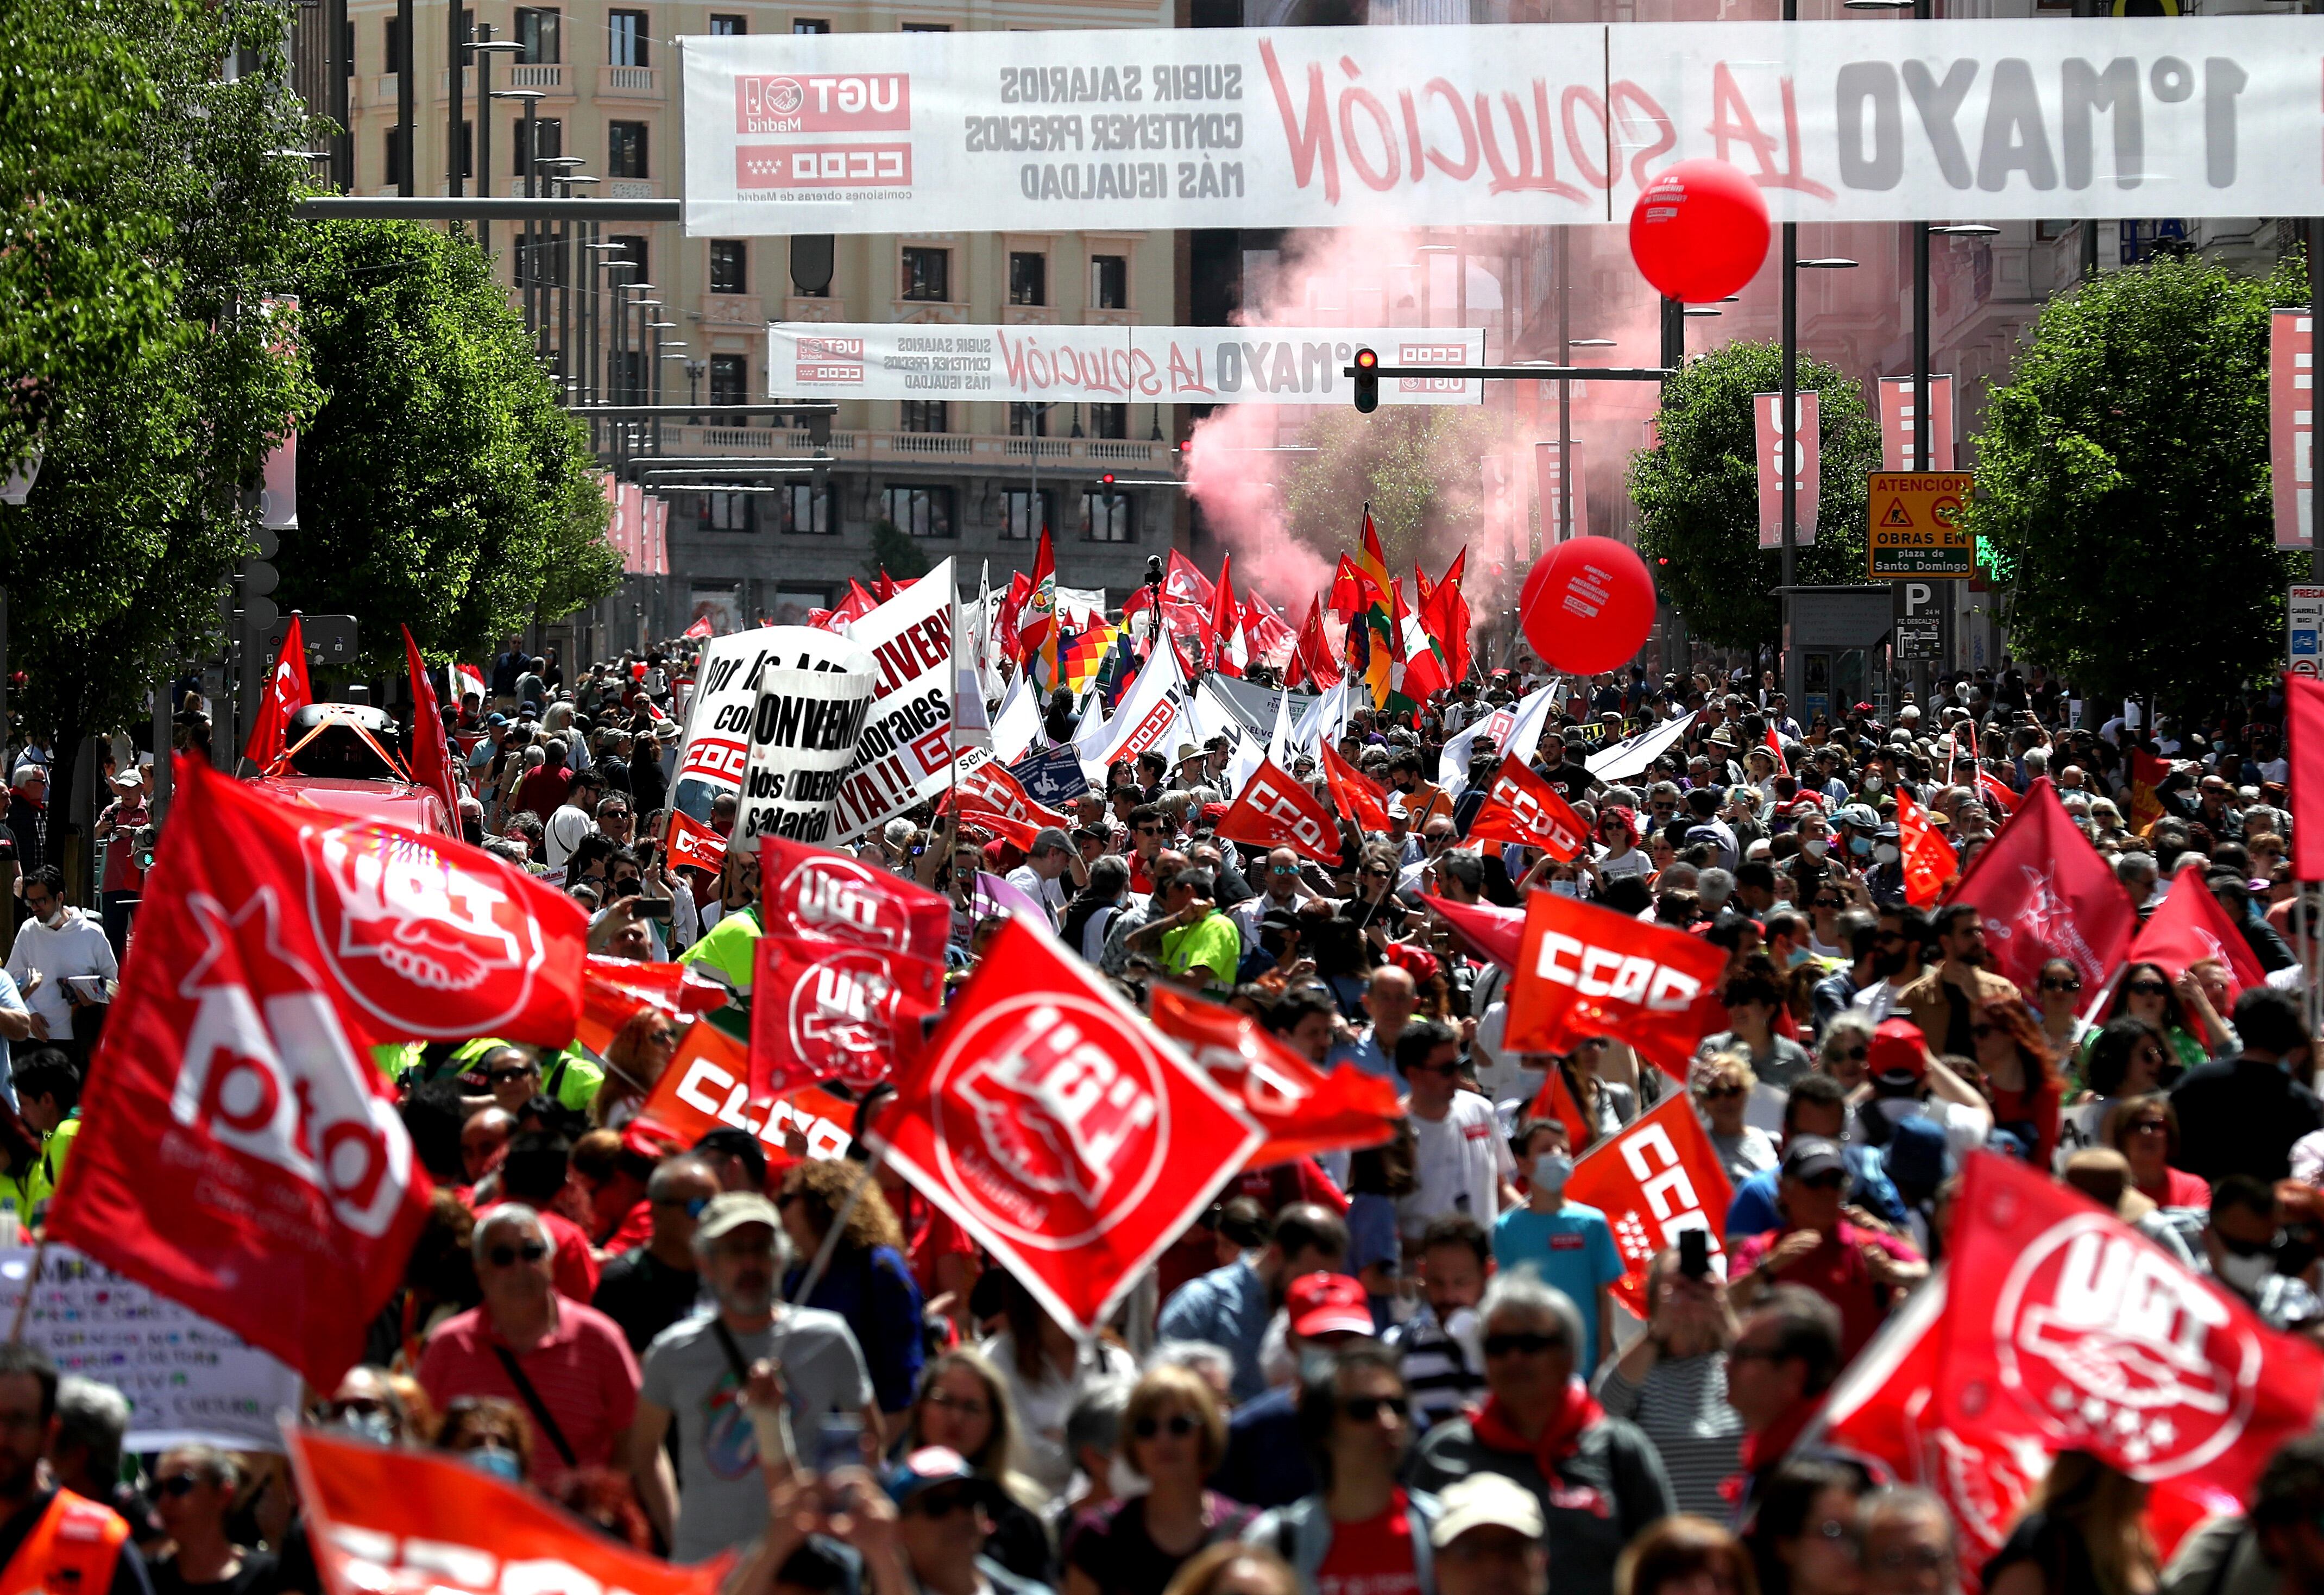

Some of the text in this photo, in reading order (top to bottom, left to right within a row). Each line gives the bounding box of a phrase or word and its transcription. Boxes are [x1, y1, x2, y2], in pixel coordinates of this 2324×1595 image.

[1877, 476, 1967, 491] ATENCIÓN
[1875, 561, 1968, 572] Santo Domingo
[1878, 533, 1966, 544] OBRAS EN
[1898, 549, 1944, 558] plaza de
[1566, 597, 1588, 611] CCOO
[1906, 583, 1931, 616] P
[870, 603, 950, 703] LIVER
[848, 688, 950, 772] borales
[1492, 776, 1576, 852] CCOO
[322, 828, 511, 931] UGT
[798, 869, 884, 928] UGT
[1536, 930, 1702, 1013] CCOO
[675, 1056, 853, 1162] CCOO
[2052, 1232, 2229, 1371] UGT
